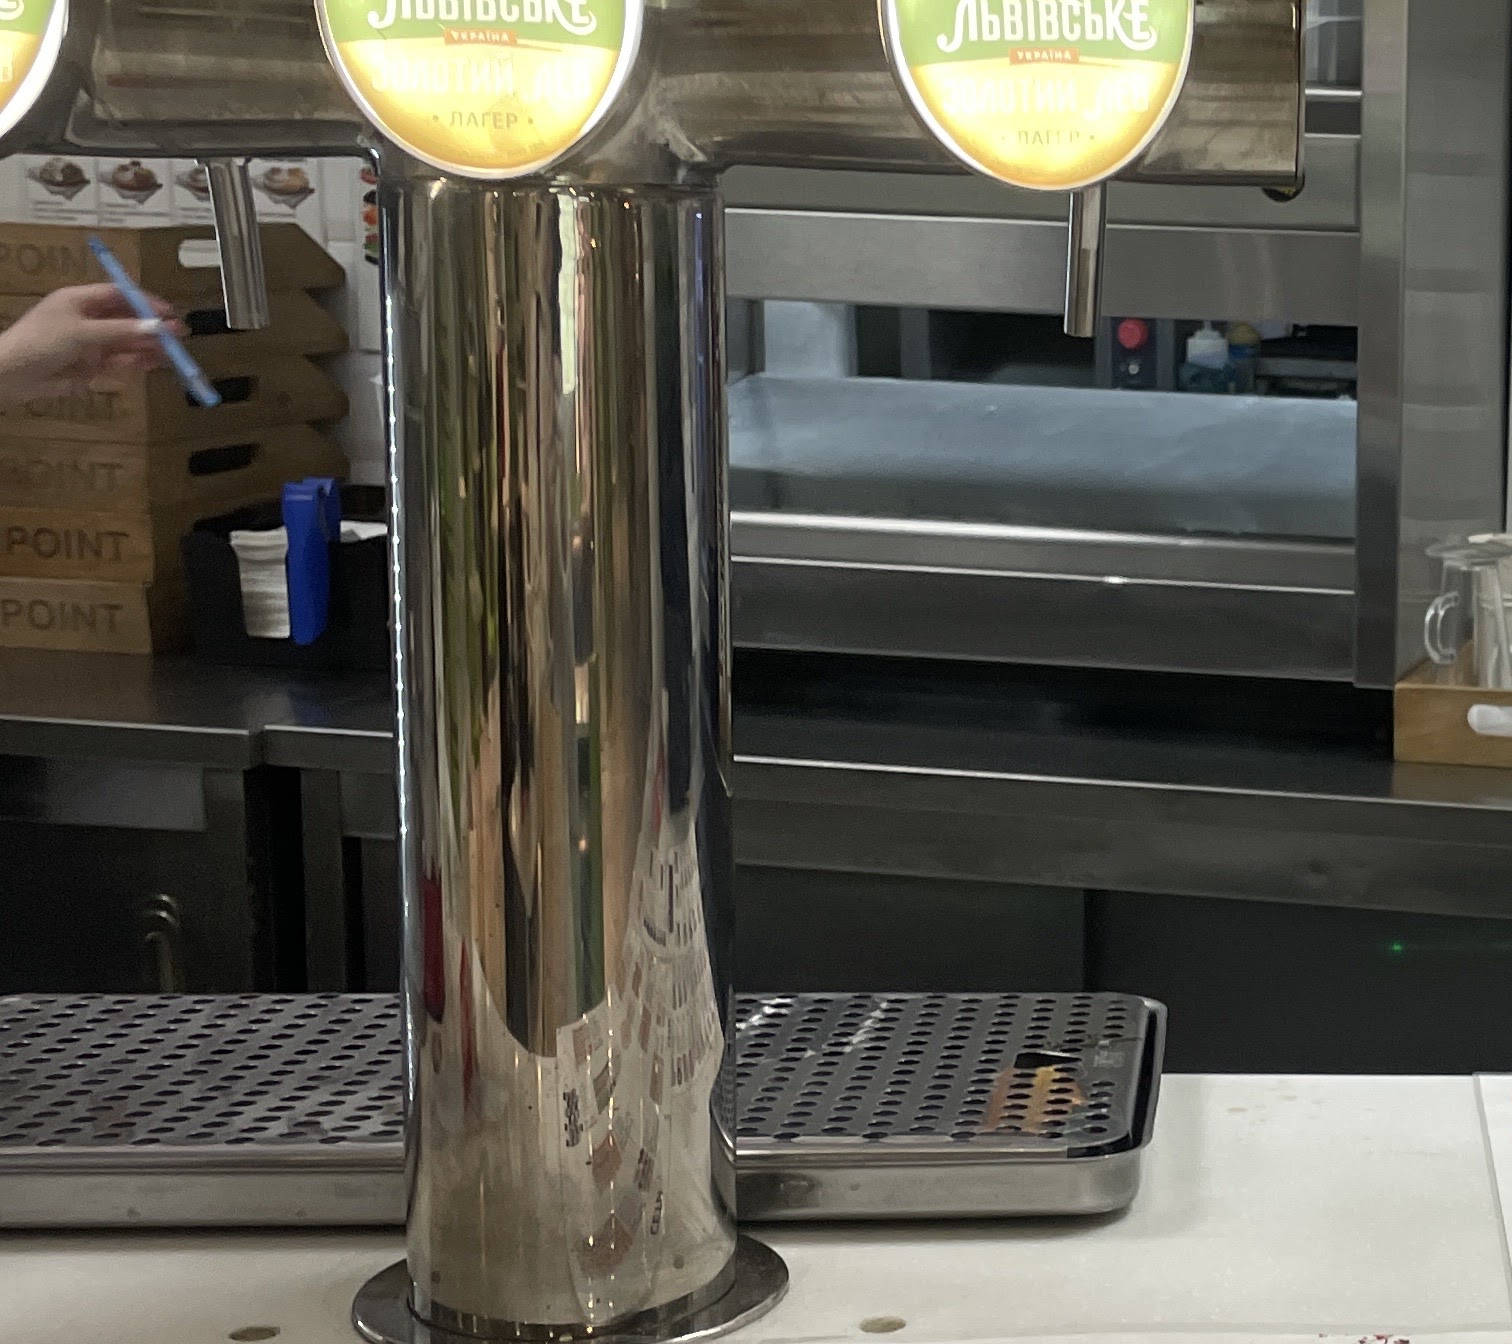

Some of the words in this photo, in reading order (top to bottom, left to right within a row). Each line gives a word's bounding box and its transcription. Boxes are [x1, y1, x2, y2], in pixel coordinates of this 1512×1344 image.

[449, 27, 512, 45] УКРАЇНА
[1016, 49, 1073, 62] УКРАЇНА
[449, 110, 519, 130] ЛАГЕР
[6, 525, 130, 561] POINT
[1, 598, 124, 633] POINT
